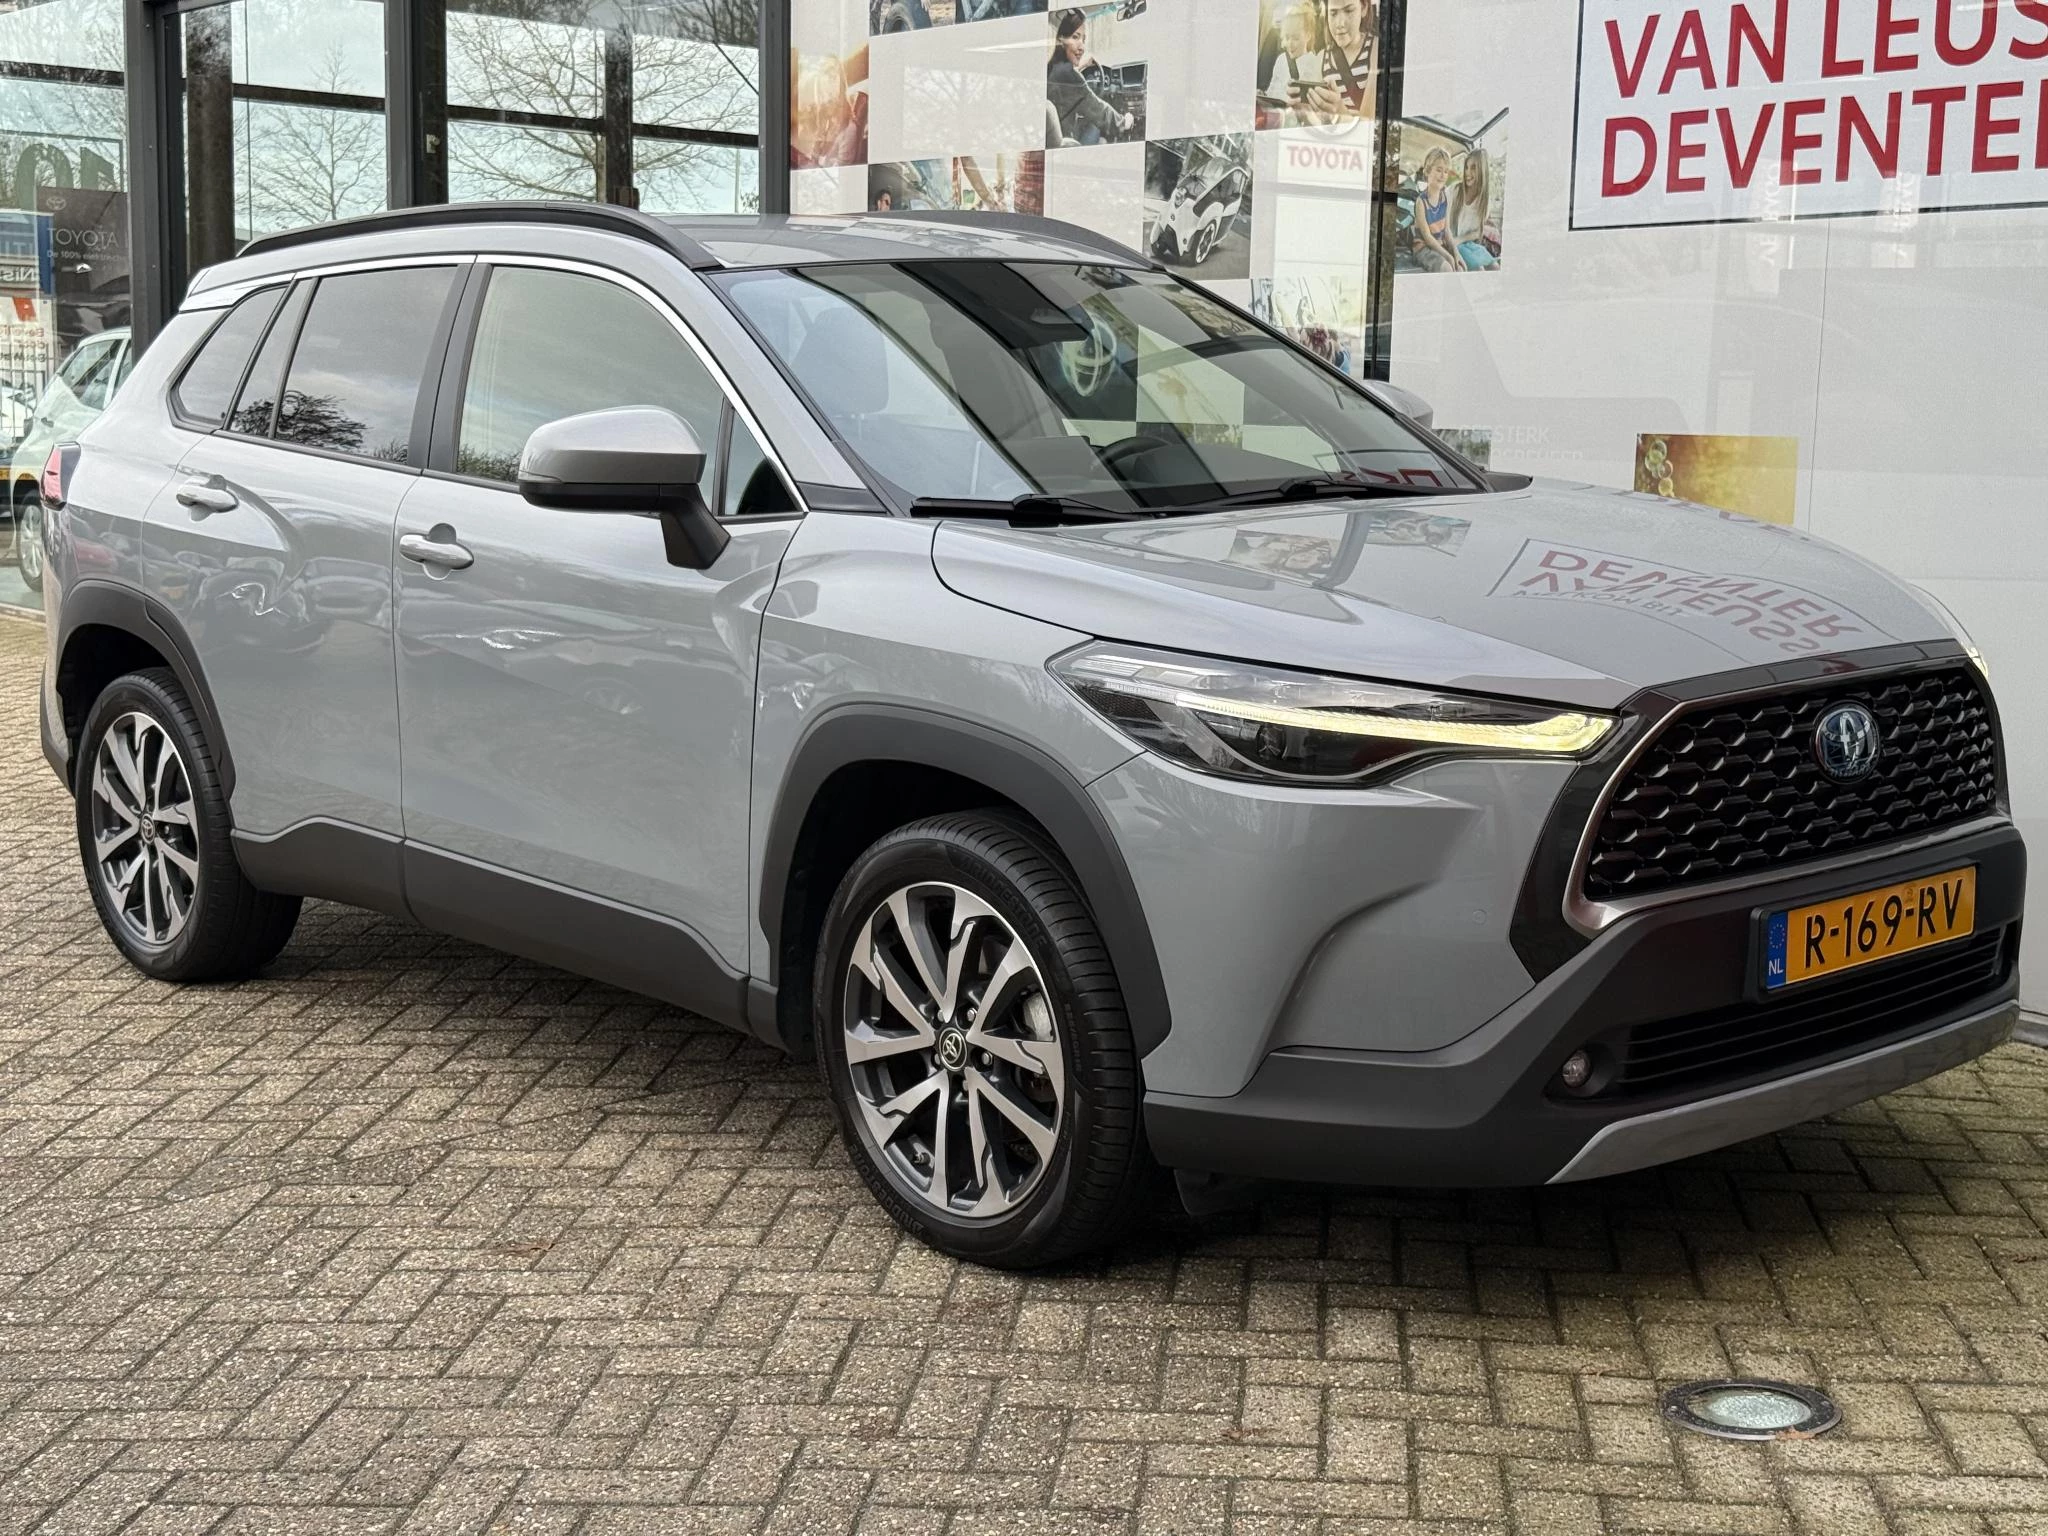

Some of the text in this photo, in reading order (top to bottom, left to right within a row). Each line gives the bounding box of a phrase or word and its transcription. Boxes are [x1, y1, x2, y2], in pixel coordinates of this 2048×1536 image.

[1604, 0, 1788, 99] VAN
[1286, 145, 1363, 171] TOYOTA
[1601, 79, 2048, 198] DEVENTE
[47, 227, 119, 250] TOYOTA
[1804, 879, 1963, 969] R-169-RV
[1768, 960, 1784, 977] NL
